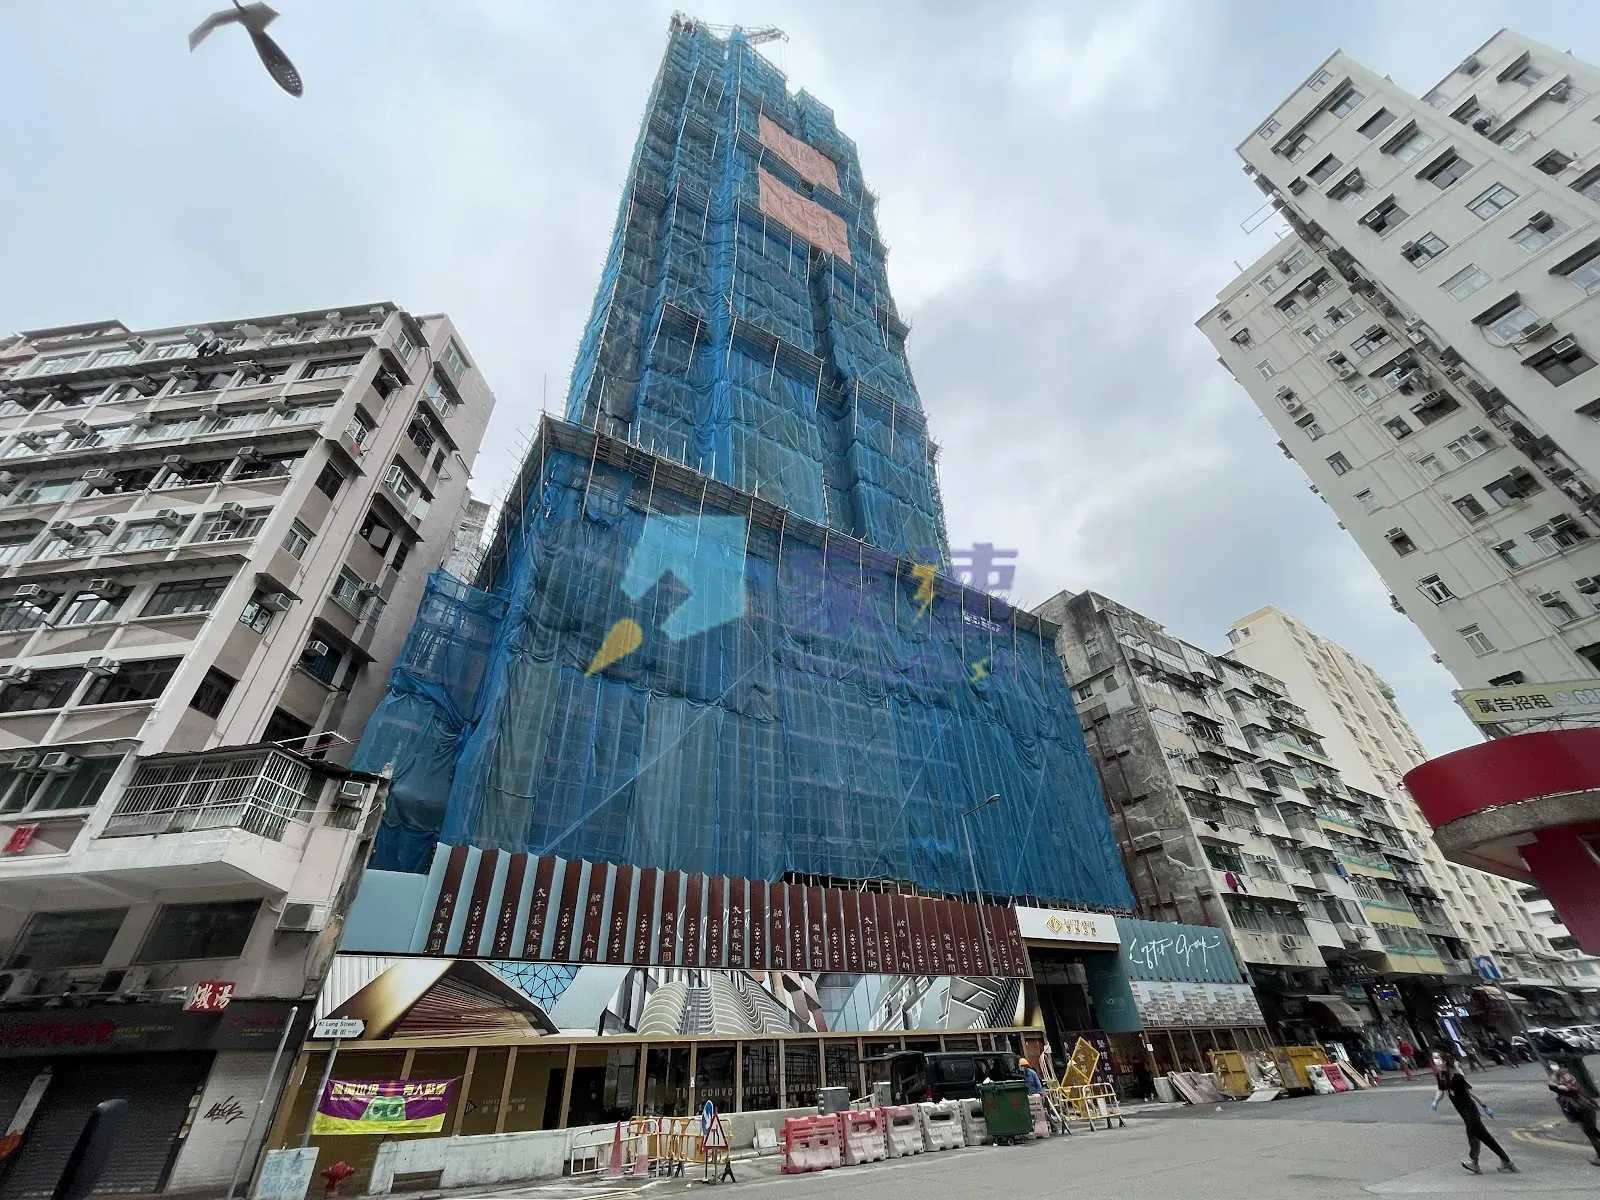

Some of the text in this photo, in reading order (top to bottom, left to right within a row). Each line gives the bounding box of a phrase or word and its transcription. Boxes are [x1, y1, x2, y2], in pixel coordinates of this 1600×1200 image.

[1475, 694, 1554, 714] 廣告招租
[526, 887, 547, 955] 太子基隆街
[701, 1085, 770, 1098] conveence
[789, 1079, 853, 1093] conseation
